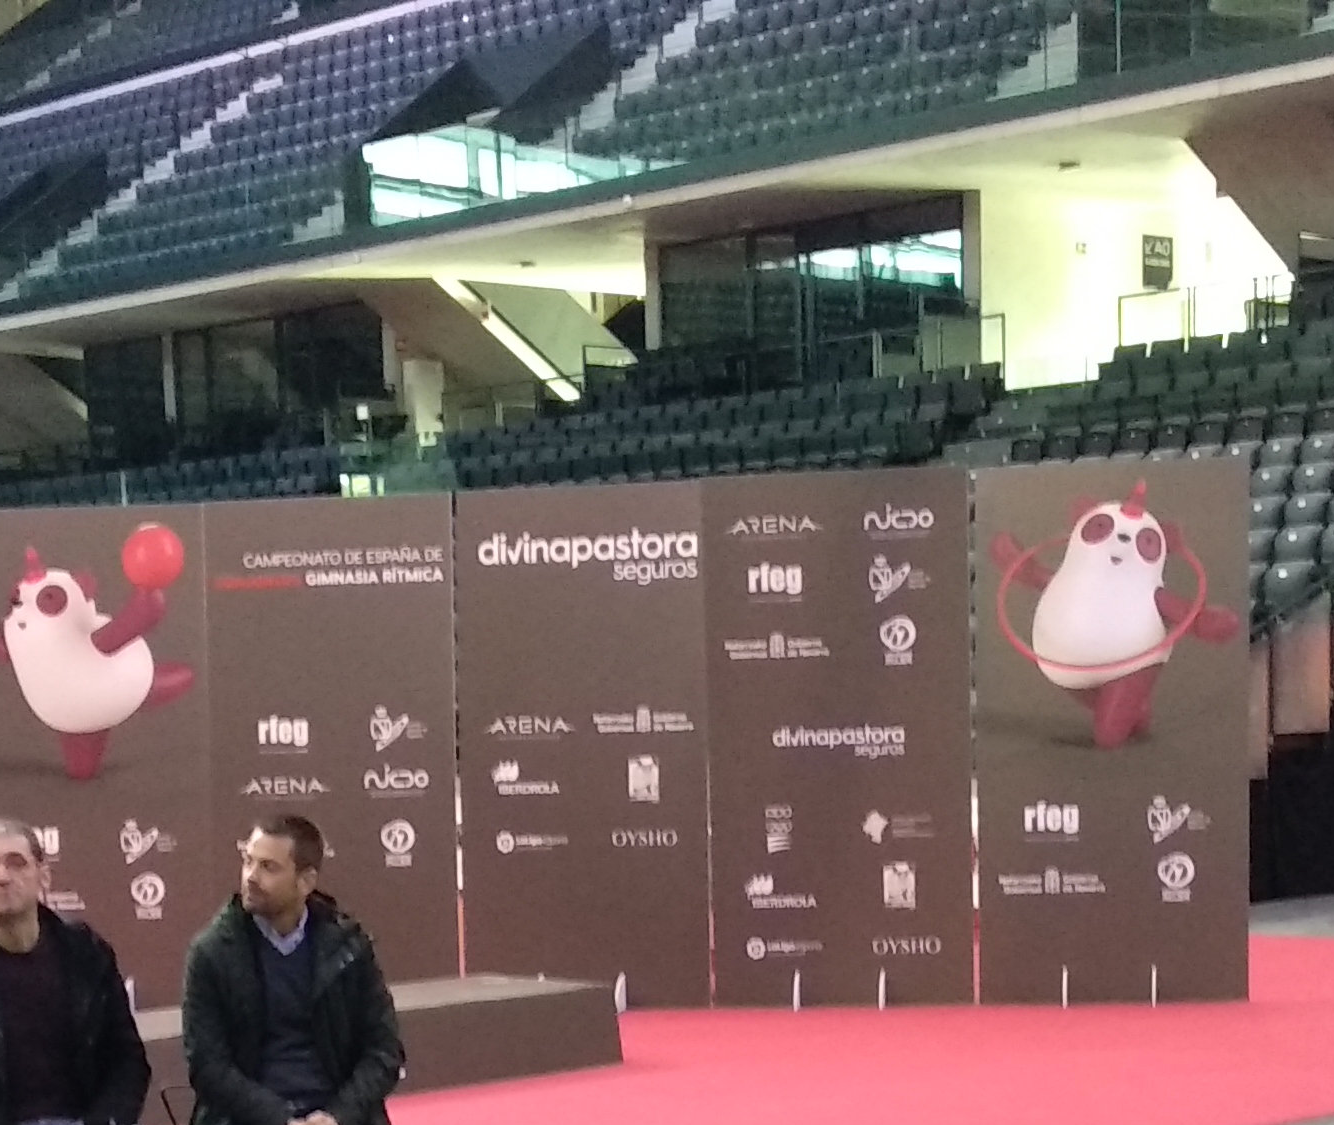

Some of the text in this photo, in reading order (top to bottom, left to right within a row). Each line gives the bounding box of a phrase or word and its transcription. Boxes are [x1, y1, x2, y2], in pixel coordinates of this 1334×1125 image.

[725, 515, 823, 536] ARENA
[242, 544, 444, 569] CAMPEONATO DE ESPAÑA DE
[477, 527, 699, 569] divinapastora
[304, 569, 380, 587] GIMNASIA
[613, 558, 699, 586] seguros
[483, 715, 576, 735] ARENA
[772, 723, 906, 749] divinapastora
[854, 743, 906, 759] seguros
[242, 776, 331, 795] ARENA
[611, 829, 678, 848] OYSHO
[872, 936, 942, 955] OYSHO
